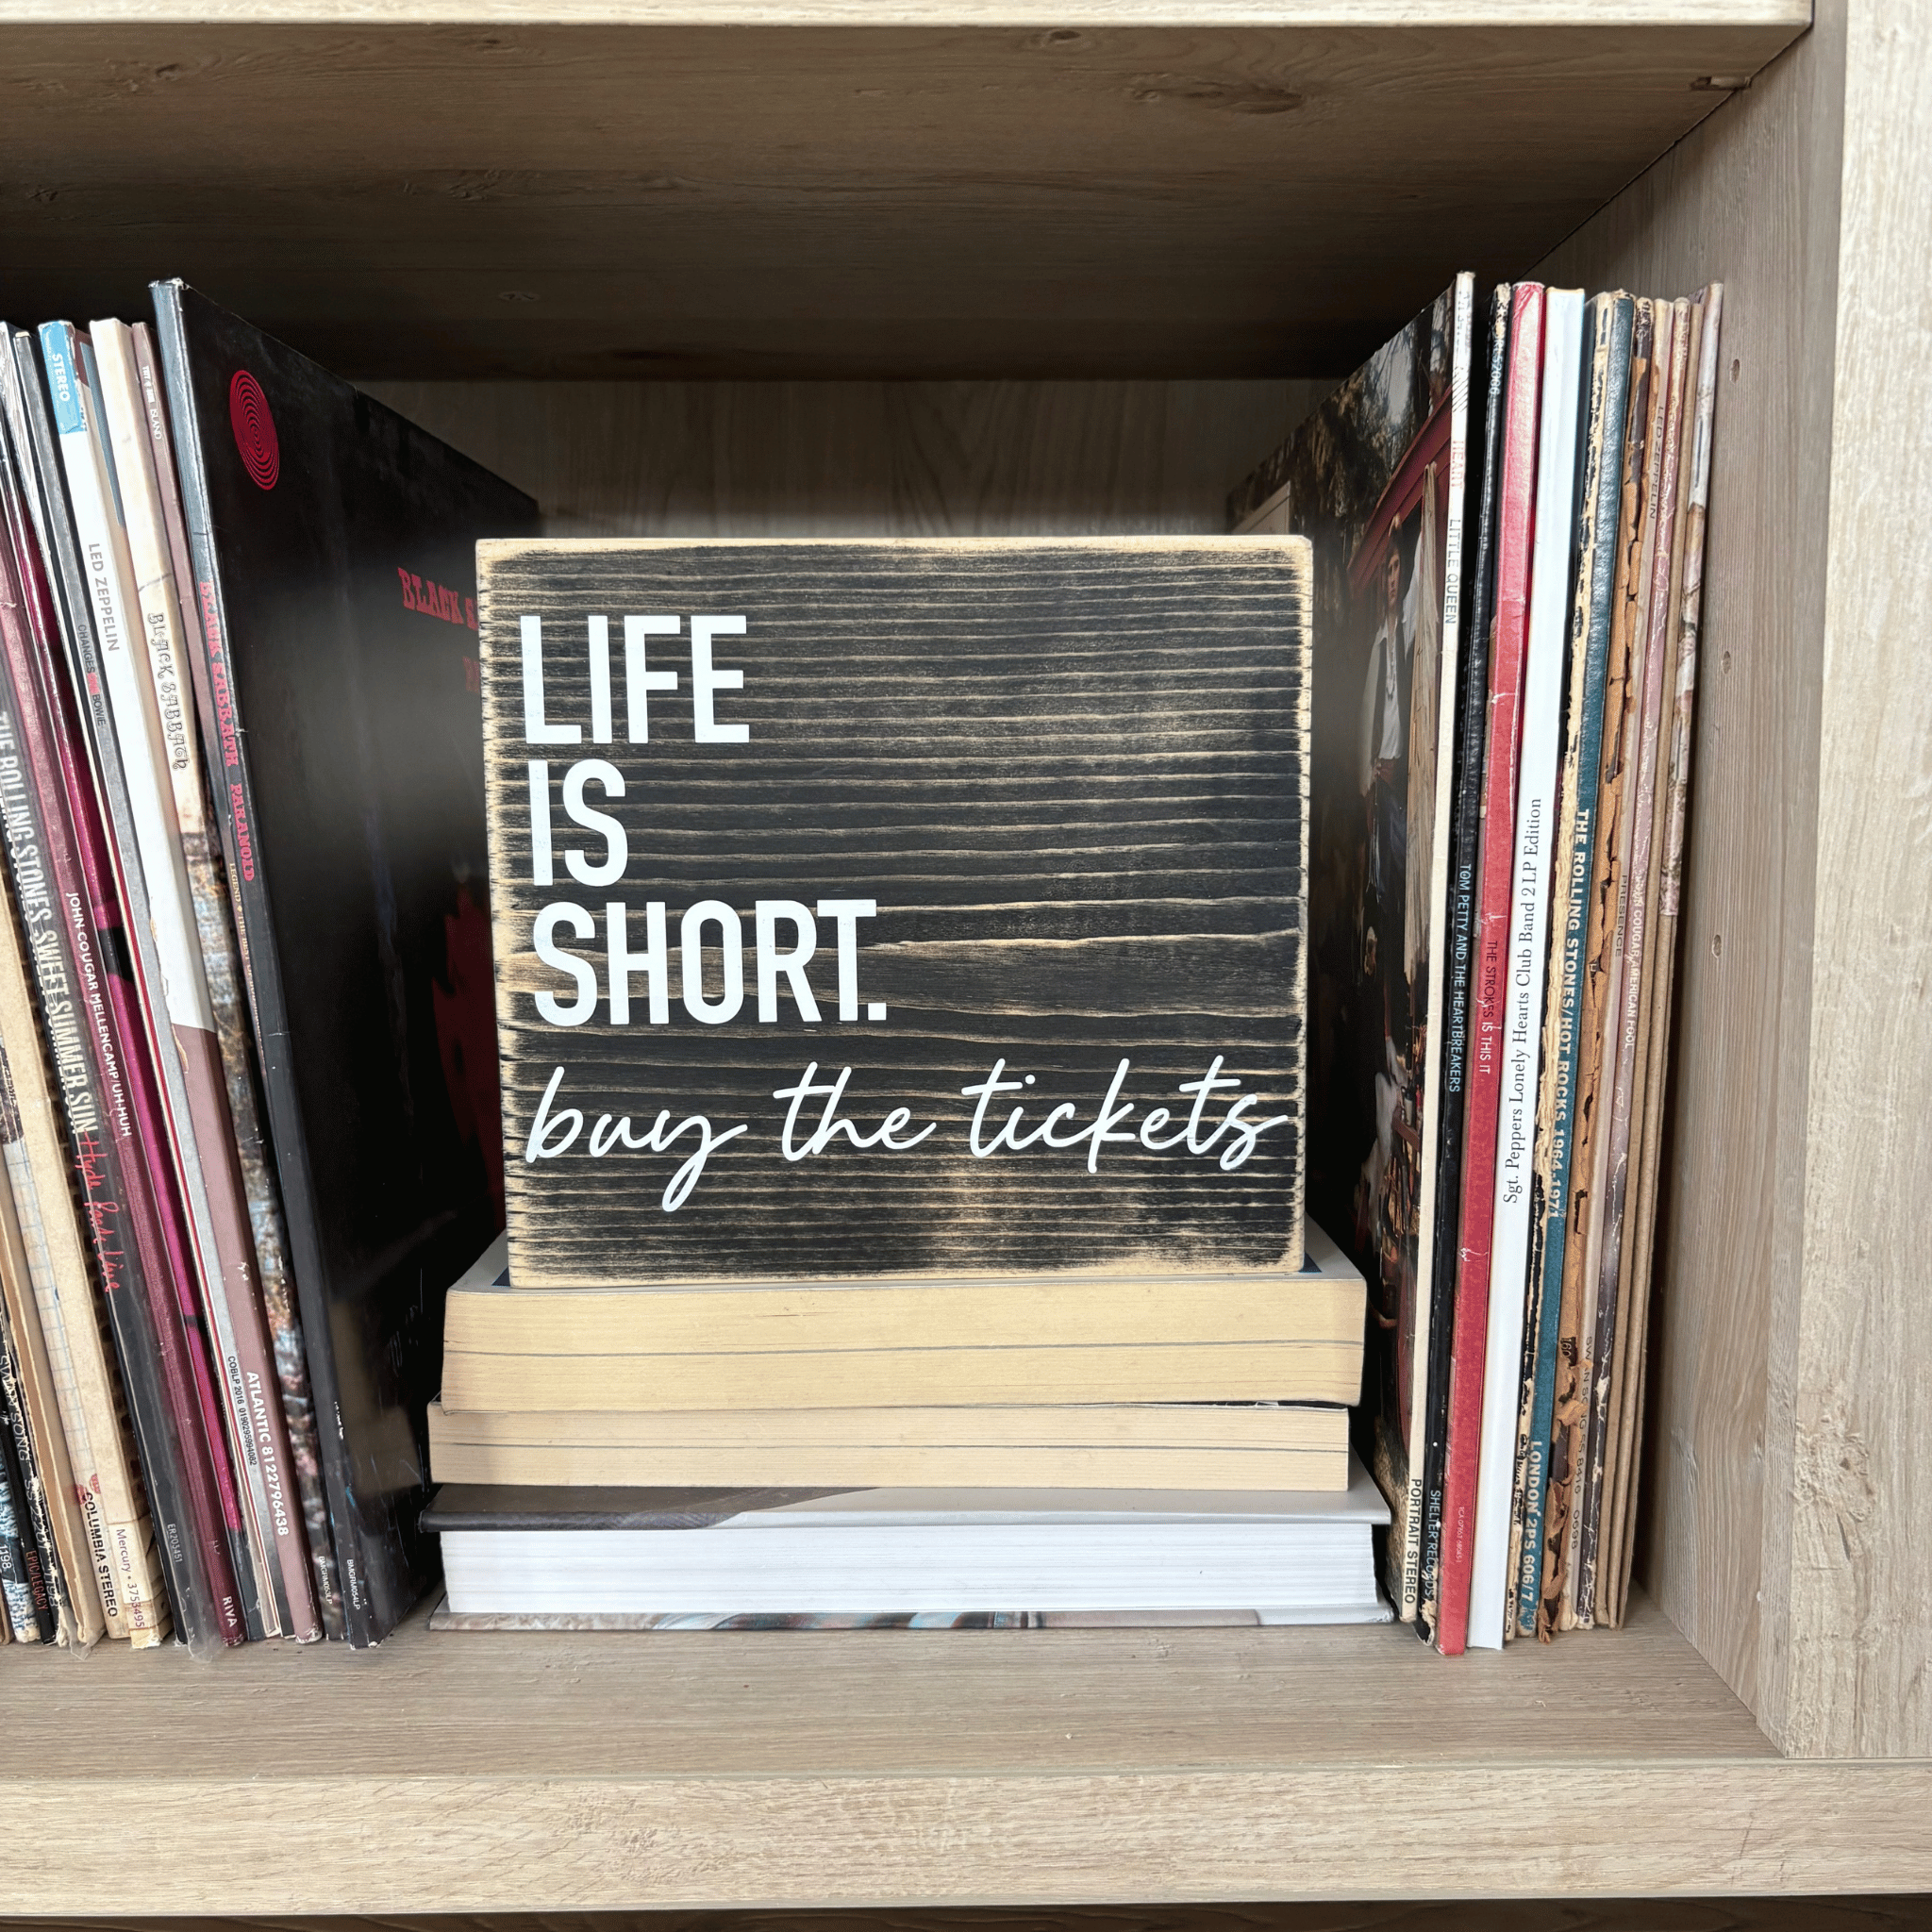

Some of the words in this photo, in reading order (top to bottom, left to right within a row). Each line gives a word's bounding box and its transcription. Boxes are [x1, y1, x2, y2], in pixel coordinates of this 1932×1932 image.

[51, 353, 71, 403] STEREO
[150, 408, 162, 441] ISLAND
[1655, 406, 1664, 439] LED
[1450, 440, 1466, 490] HEART
[1649, 440, 1662, 520] ZEPPELIN
[89, 542, 104, 572] LED
[1448, 518, 1461, 569] LITTLE
[93, 575, 120, 653] ZEPPELIN
[397, 567, 465, 625] BLACK
[1444, 573, 1459, 625] QUEEN
[148, 612, 175, 679] BLACK
[162, 680, 190, 772] SABBATH
[521, 614, 750, 744] LIFE
[199, 580, 223, 658] BLACK
[211, 660, 240, 767] SABBATH
[229, 783, 255, 882] PARANOID
[528, 758, 628, 887] IS
[1523, 798, 1542, 857] Edition
[1576, 808, 1591, 844] THE
[13, 844, 52, 926] STONES
[229, 862, 242, 903] LEGEND
[1459, 863, 1472, 890] TOM
[1568, 851, 1586, 931] ROLLING
[66, 891, 86, 932] JOHN
[1457, 893, 1470, 930] PETTY
[1517, 902, 1535, 943] Band
[1615, 874, 1628, 958] PRESENCE
[28, 929, 70, 997] SWEET
[72, 931, 98, 993] COUGAR
[533, 898, 887, 1026] SHORT.
[1456, 932, 1469, 961] AND
[1486, 940, 1498, 963] THE
[1514, 948, 1533, 987] Club
[1454, 963, 1466, 987] THE
[1483, 966, 1497, 1019] STROKES
[1558, 937, 1579, 1055] STONES/HOT
[1626, 959, 1641, 1017] AMERICAN
[1448, 991, 1465, 1093] HEARTBREAKERS
[1481, 1022, 1493, 1033] IS
[1511, 991, 1530, 1043] Hearts
[1624, 1018, 1636, 1049] FOOL
[47, 998, 89, 1091] SUMMER
[91, 992, 132, 1138] MELLENCAMP/UH-HUH
[1478, 1063, 1491, 1075] IT
[1480, 1036, 1492, 1061] THIS
[1507, 1049, 1531, 1104] Lonely
[1555, 1060, 1570, 1122] ROCKS
[65, 1091, 99, 1135] SUN
[525, 1066, 748, 1212] buy
[773, 1061, 937, 1162] the
[961, 1055, 1289, 1174] tickets
[1505, 1108, 1527, 1170] Peppers
[1502, 1174, 1523, 1205] Sgt.
[227, 1355, 241, 1386] COBLP
[1582, 1337, 1592, 1382] SWN
[233, 1385, 244, 1405] 2016
[10, 1411, 29, 1461] SONG
[246, 1371, 273, 1453] ATLANTIC
[261, 1445, 290, 1537] 8122796438
[1526, 1440, 1542, 1515] LONDON
[1407, 1478, 1422, 1547] PORTRAIT
[1428, 1490, 1441, 1540] SHELTER
[1524, 1517, 1538, 1551] 2PS
[1571, 1509, 1581, 1550] 0698
[0, 1544, 12, 1570] 1198
[81, 1491, 108, 1562] COLUMBIA
[97, 1565, 118, 1618] STEREO
[167, 1523, 183, 1563] ER203451
[25, 1550, 49, 1611] EPIC/LEGACY
[115, 1527, 132, 1574] Mercury
[126, 1582, 145, 1628] 3753495
[346, 1559, 361, 1610] BMGRM054LP
[1404, 1550, 1419, 1605] STEREO
[1425, 1541, 1438, 1598] RECORDS
[1521, 1554, 1536, 1603] 606/7
[223, 1595, 238, 1628] RIVA
